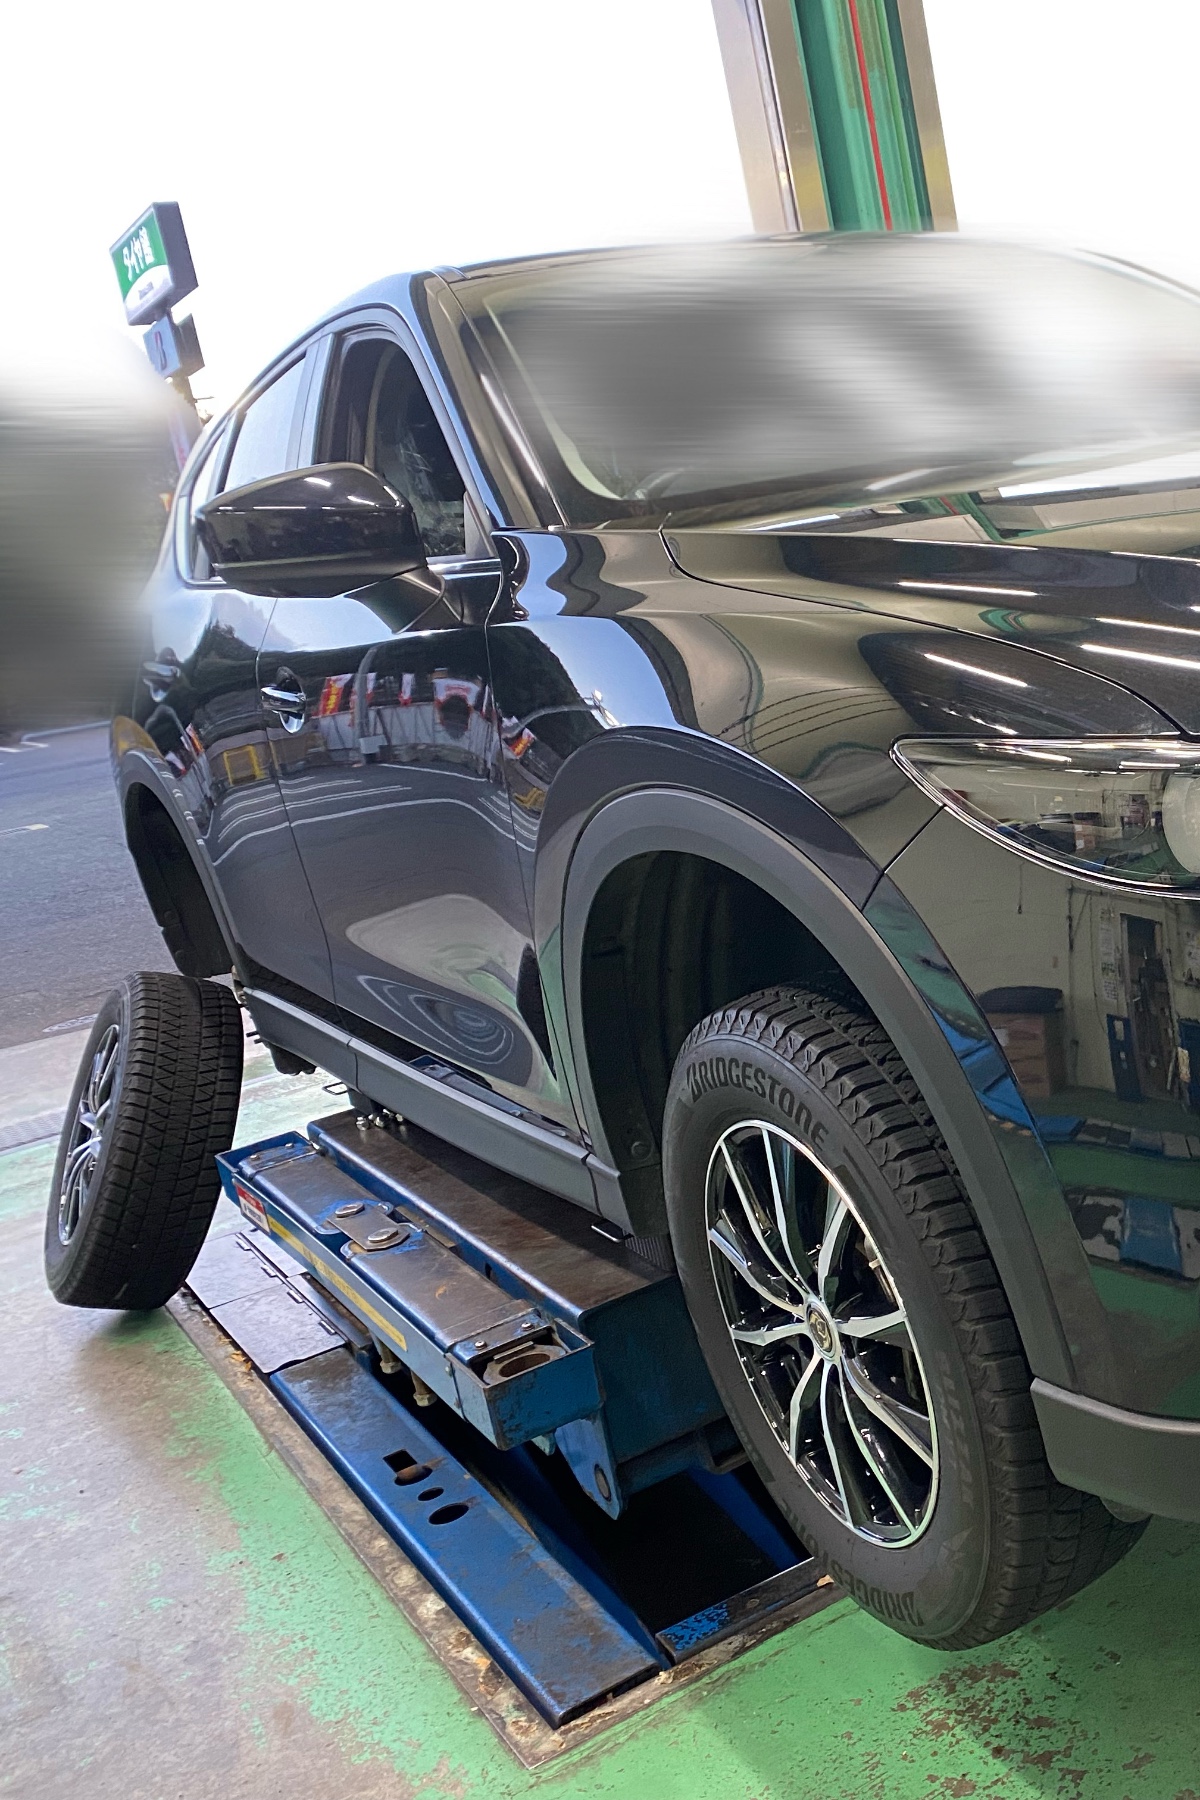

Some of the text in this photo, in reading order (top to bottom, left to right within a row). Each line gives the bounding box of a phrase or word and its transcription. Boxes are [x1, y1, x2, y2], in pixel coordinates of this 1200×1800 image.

[122, 226, 155, 281] タイヤ館
[687, 1057, 829, 1151] BRIDGESTONE
